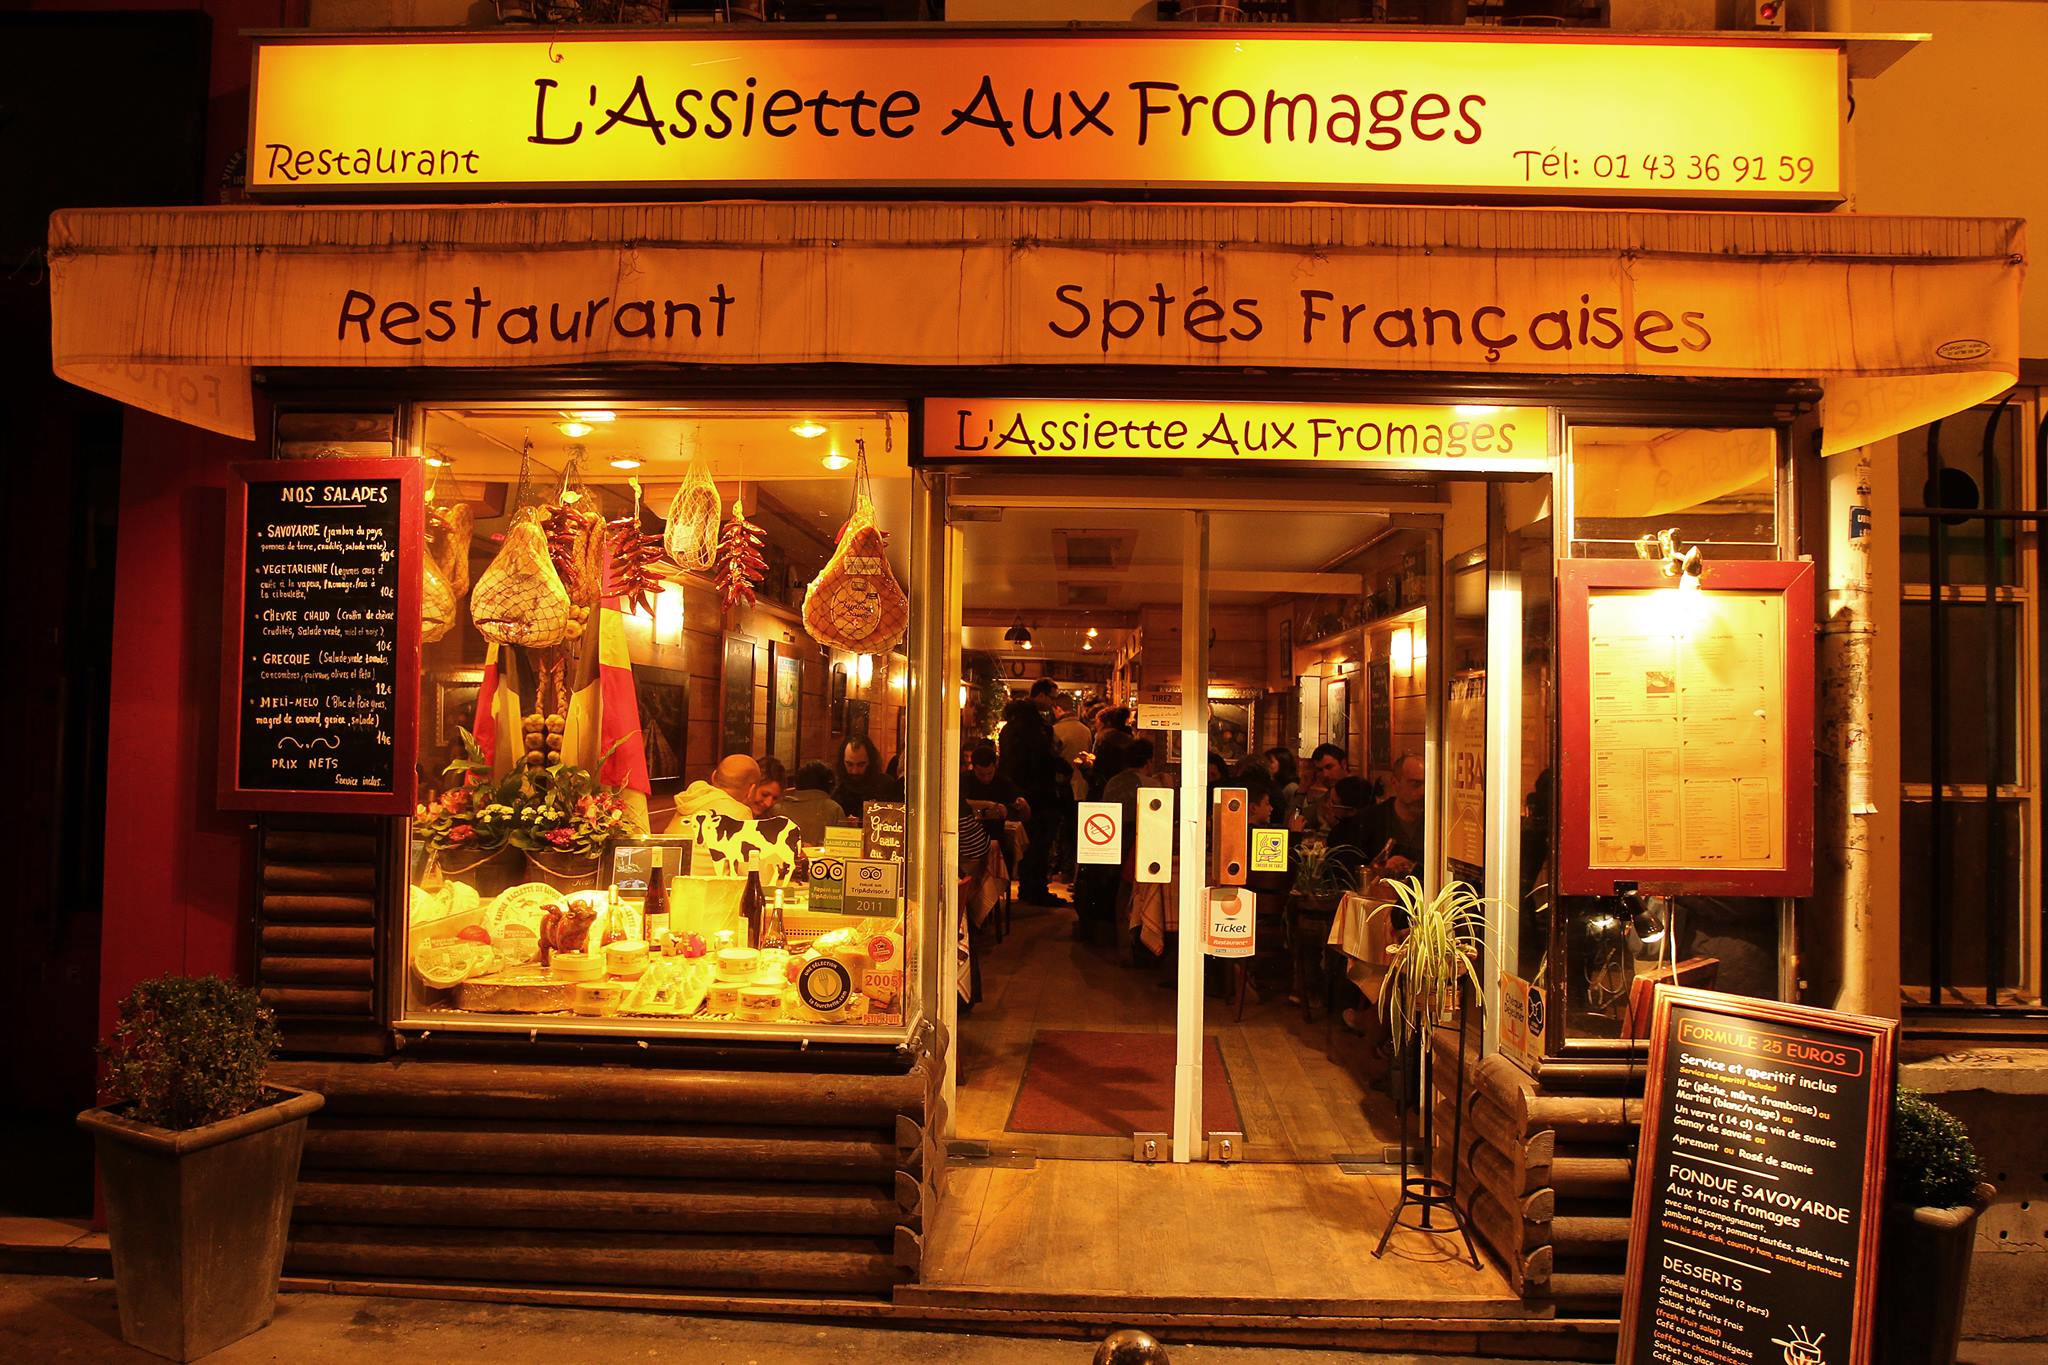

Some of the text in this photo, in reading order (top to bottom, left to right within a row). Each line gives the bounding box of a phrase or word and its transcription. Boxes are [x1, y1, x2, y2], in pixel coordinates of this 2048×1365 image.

[528, 75, 1486, 151] L'Assiette Aux Fromages
[266, 144, 480, 180] Restaurant
[1513, 146, 1814, 184] Tél: 01 43 36 91 59
[337, 284, 736, 346] Restaurant
[1049, 283, 1712, 363] Sptés Françaises
[954, 410, 1515, 458] L'Assiette Aux Fromages
[281, 486, 388, 503] NOS SALADES
[267, 524, 320, 538] SAVOYARDE
[356, 525, 365, 535] du
[287, 541, 295, 550] de
[262, 564, 328, 575] VEGETARIENNE
[263, 609, 298, 621] CHEVRE
[304, 611, 331, 621] CHAUD
[365, 609, 374, 620] de
[297, 625, 321, 636] Salade
[263, 652, 311, 665] GRECQUE
[376, 640, 392, 652] 10€
[376, 682, 392, 696] 12€
[284, 713, 292, 724] de
[376, 730, 391, 746] 14€
[272, 757, 339, 769] PRIX NETS
[870, 815, 904, 842] Grande
[857, 901, 882, 911] 2011
[1215, 923, 1247, 933] Ticket
[865, 974, 899, 987] 2005
[1683, 1024, 1847, 1066] FORMULE 25 EUROS
[1680, 1066, 1705, 1077] Service
[1680, 1053, 1726, 1072] Service
[1728, 1062, 1743, 1075] et
[1799, 1076, 1838, 1094] inclus
[1676, 1089, 1794, 1124] Martini (blanc/rouge) ou
[1677, 1078, 1692, 1088] Kir
[1760, 1095, 1818, 1118] framboise)
[1818, 1111, 1831, 1120] ou
[1673, 1115, 1766, 1145] Gamay de savoie ou
[1675, 1104, 1689, 1115] Un
[1690, 1108, 1717, 1122] verre
[1740, 1117, 1754, 1131] cl)
[1755, 1121, 1769, 1133] de
[1770, 1126, 1786, 1137] vin
[1787, 1129, 1801, 1140] de
[1803, 1134, 1837, 1149] savoie
[1672, 1133, 1814, 1175] Apremont ou Rosé de savoie
[1665, 1198, 1682, 1208] avec
[1683, 1203, 1697, 1212] son
[1666, 1182, 1801, 1228] Aux trois fromages
[1669, 1164, 1851, 1224] FONDUE SAVOYARDE
[1661, 1219, 1679, 1231] With
[1680, 1224, 1690, 1234] his
[1692, 1227, 1706, 1239] side
[1726, 1240, 1755, 1255] country
[1775, 1253, 1805, 1267] sauteed
[1807, 1262, 1843, 1279] potatoes
[1664, 1208, 1691, 1223] jambon
[1692, 1216, 1703, 1225] de
[1726, 1226, 1758, 1241] pommes
[1796, 1245, 1823, 1260] salade
[1824, 1253, 1850, 1267] verte
[1663, 1255, 1743, 1291] DESSERTS
[1659, 1286, 1711, 1309] Crème brûlée
[1660, 1274, 1688, 1290] Fondue
[1701, 1289, 1734, 1305] chocolat
[1736, 1299, 1745, 1309] (2
[1747, 1304, 1769, 1318] pers)
[1656, 1307, 1722, 1337] (fresh fruit salad)
[1658, 1297, 1744, 1332] Salade de fruits frais
[1653, 1329, 1690, 1348] (coffee or
[1654, 1340, 1681, 1355] Sorbet
[1683, 1352, 1692, 1360] ou
[1656, 1318, 1753, 1358] Café ou chocolat liégeois
[1653, 1350, 1671, 1363] Café
